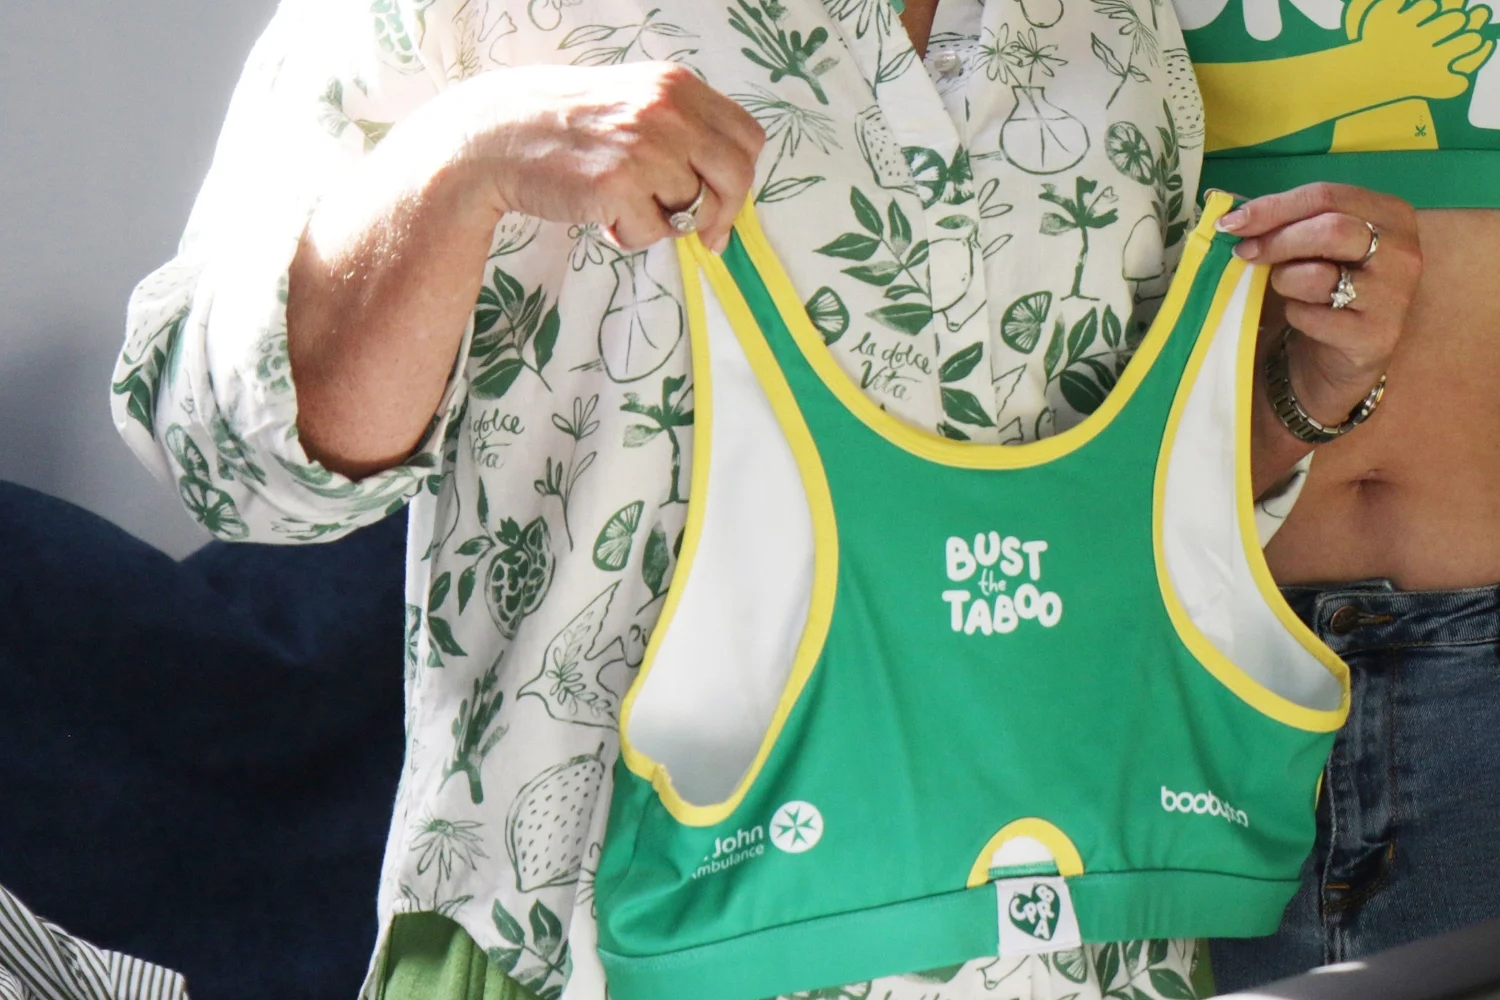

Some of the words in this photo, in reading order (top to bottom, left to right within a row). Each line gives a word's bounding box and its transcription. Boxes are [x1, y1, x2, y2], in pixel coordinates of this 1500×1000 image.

[849, 331, 877, 356] la
[881, 342, 932, 375] dolce
[473, 408, 525, 439] dolce
[945, 530, 1049, 582] BUST
[977, 568, 1007, 597] the
[941, 583, 1063, 636] TABOO
[712, 825, 764, 859] John
